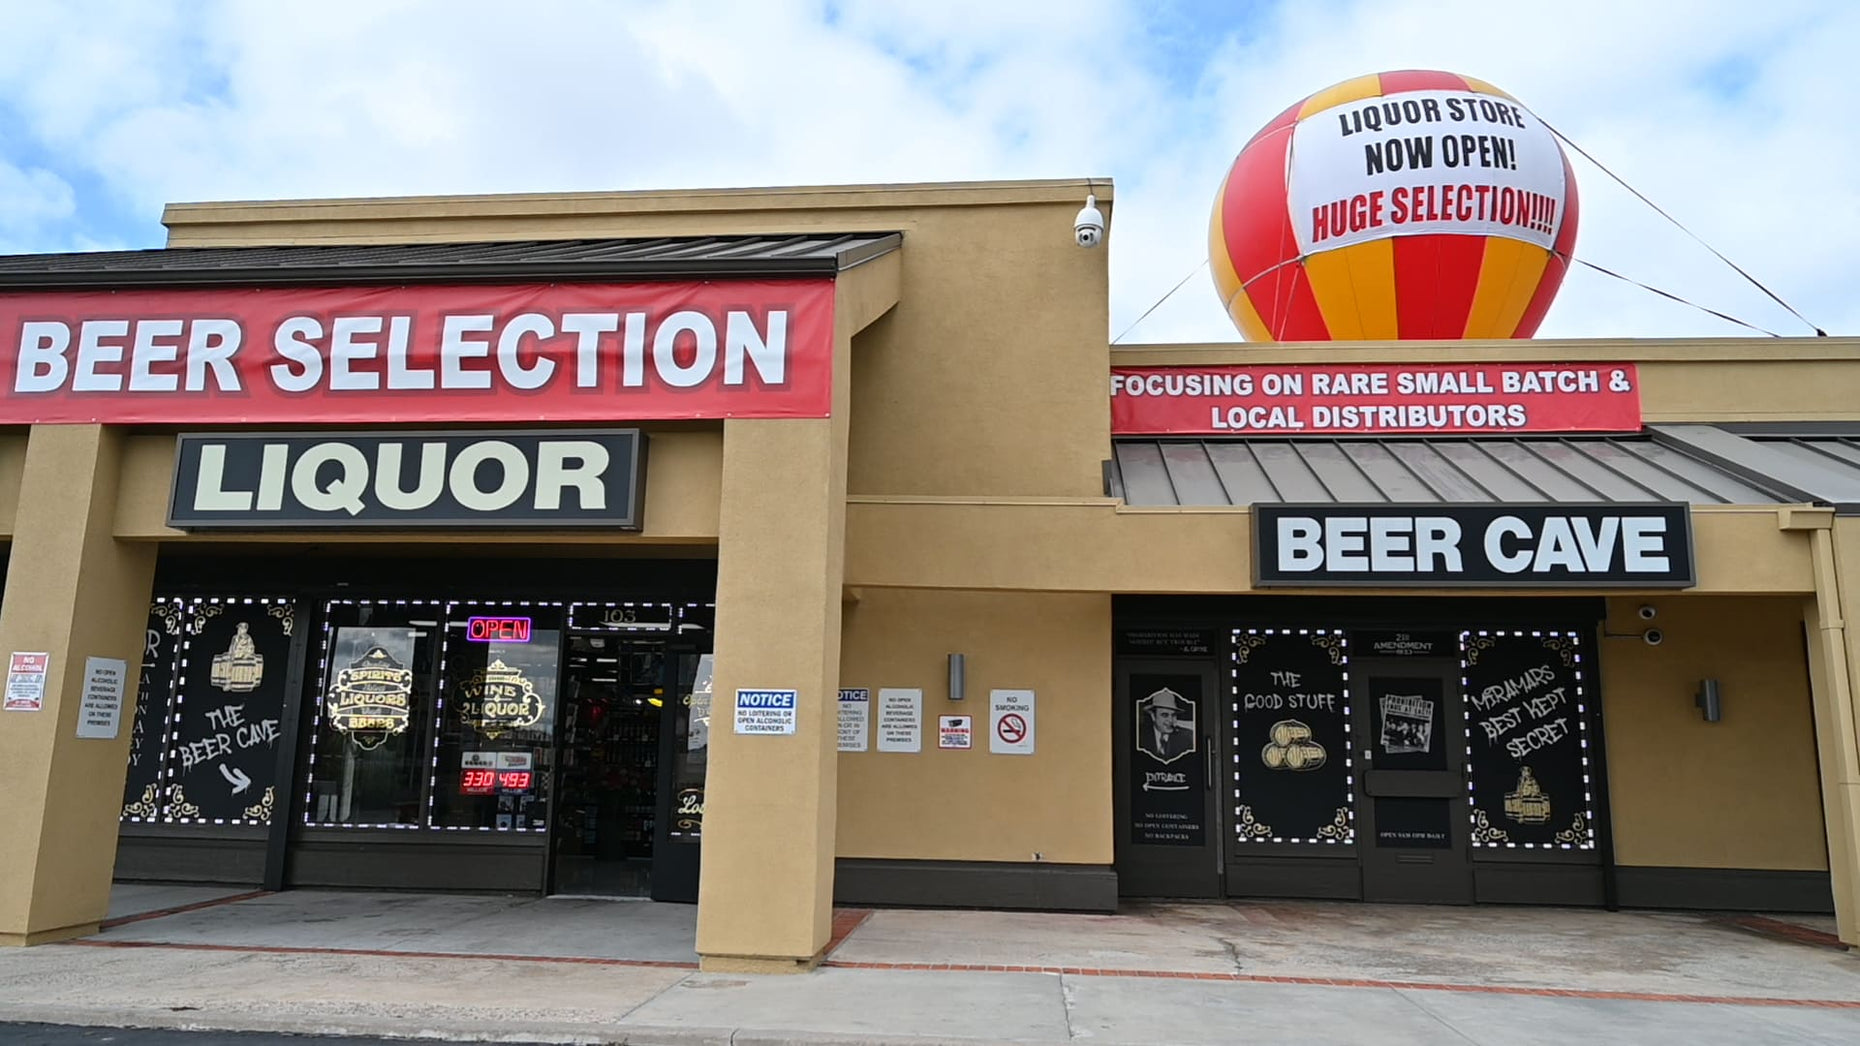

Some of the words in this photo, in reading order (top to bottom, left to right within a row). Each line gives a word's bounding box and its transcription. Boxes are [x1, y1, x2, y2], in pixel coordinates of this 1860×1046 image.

[1338, 99, 1441, 138] LIQUOR
[1449, 98, 1526, 130] STORE
[1364, 136, 1434, 177] NOW
[1441, 134, 1517, 172] OPEN!
[1312, 190, 1384, 244] HUGE
[1390, 184, 1556, 236] SELECTION!!!!
[14, 319, 242, 392] BEER
[270, 310, 788, 393] SELECTION
[1110, 374, 1253, 397] FOCUSING
[1262, 373, 1301, 396] ON
[1312, 373, 1388, 395] RARE
[1397, 371, 1493, 394] SMALL
[1502, 370, 1599, 393] BATCH
[1609, 369, 1631, 392] &
[1211, 406, 1305, 429] LOCAL
[1312, 404, 1527, 428] DISTRIBUTORS
[193, 440, 607, 517] LIQUOR
[1277, 516, 1463, 572] BEER
[1484, 515, 1670, 574] CAVE
[603, 609, 636, 624] 103
[471, 619, 528, 640] OPEN
[1373, 641, 1433, 651] AMENDMENT
[350, 670, 402, 683] SPIRITS
[1270, 671, 1302, 688] THE
[340, 692, 407, 706] LIQUORS
[465, 685, 516, 698] WINE
[739, 693, 793, 706] NOTICE
[838, 690, 867, 700] OTICE
[1244, 693, 1283, 711] GOOD
[1288, 693, 1336, 711] STUFF
[205, 702, 246, 731] THE
[471, 701, 530, 718] LIQUOR
[1479, 706, 1520, 742] BEST
[1526, 688, 1567, 720] KEPT
[756, 717, 792, 725] ALCOHOLIC
[180, 734, 233, 773] BEER
[236, 720, 282, 750] CAVE
[1505, 718, 1569, 758] SECRET
[463, 771, 495, 787] 330
[499, 771, 530, 788] 493
